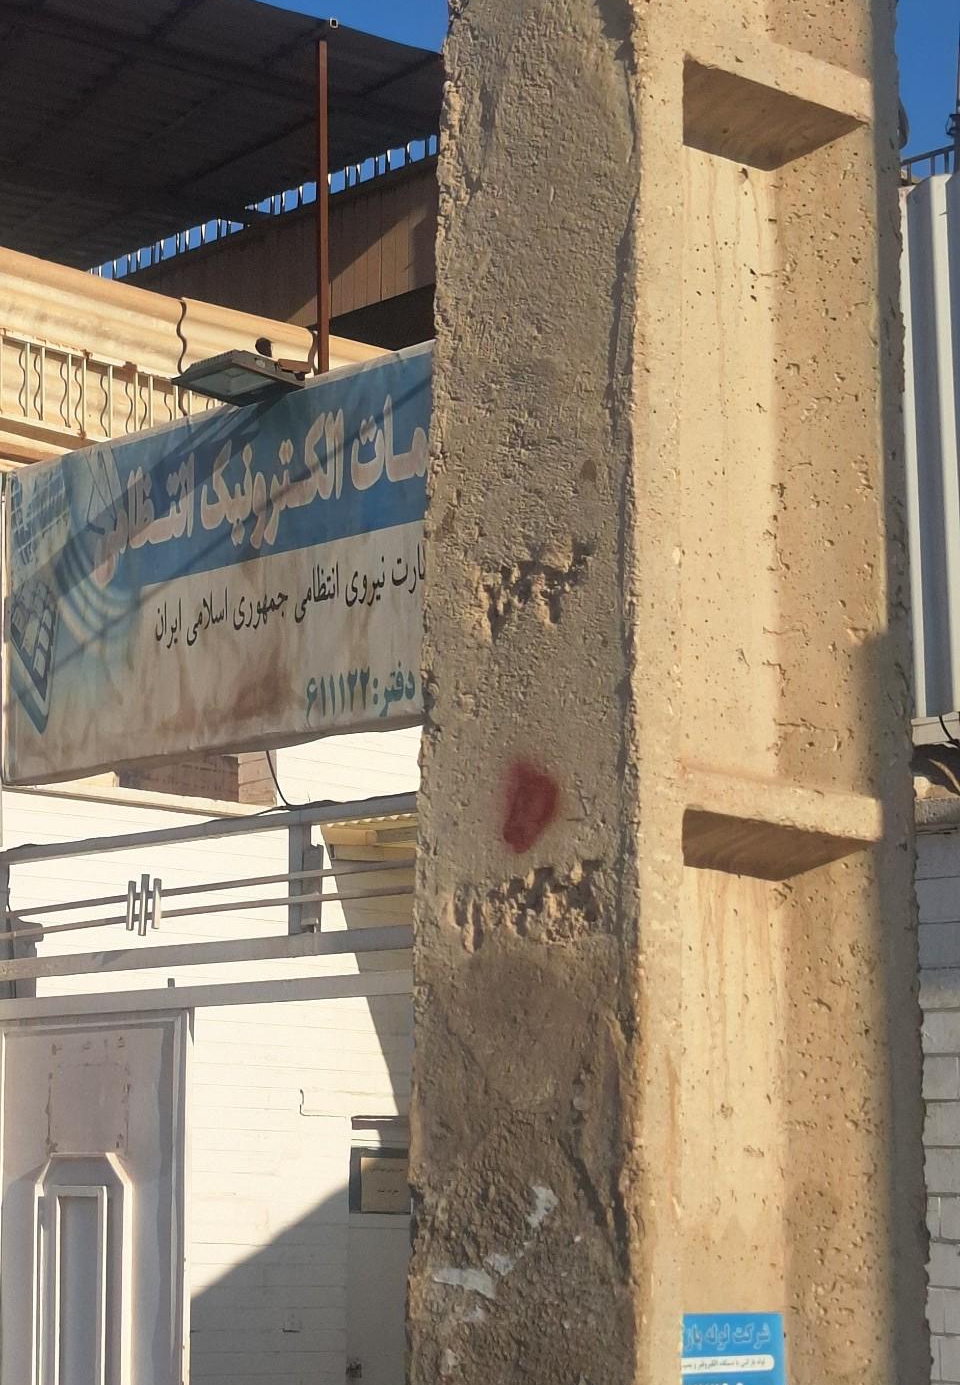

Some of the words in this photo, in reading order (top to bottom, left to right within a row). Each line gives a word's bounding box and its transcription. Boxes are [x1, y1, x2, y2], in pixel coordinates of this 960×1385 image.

[351, 394, 427, 491] مات
[200, 408, 345, 550] الکترونیک
[90, 452, 195, 589] انتظامی
[294, 559, 340, 624] انتظامی
[345, 555, 386, 608] نیروی
[390, 542, 426, 595] ارت
[155, 597, 182, 649] ایران
[186, 586, 228, 647] اسلامی
[233, 590, 289, 632] جمهوری
[704, 1322, 731, 1352] لوله
[732, 1322, 772, 1350] شرکت
